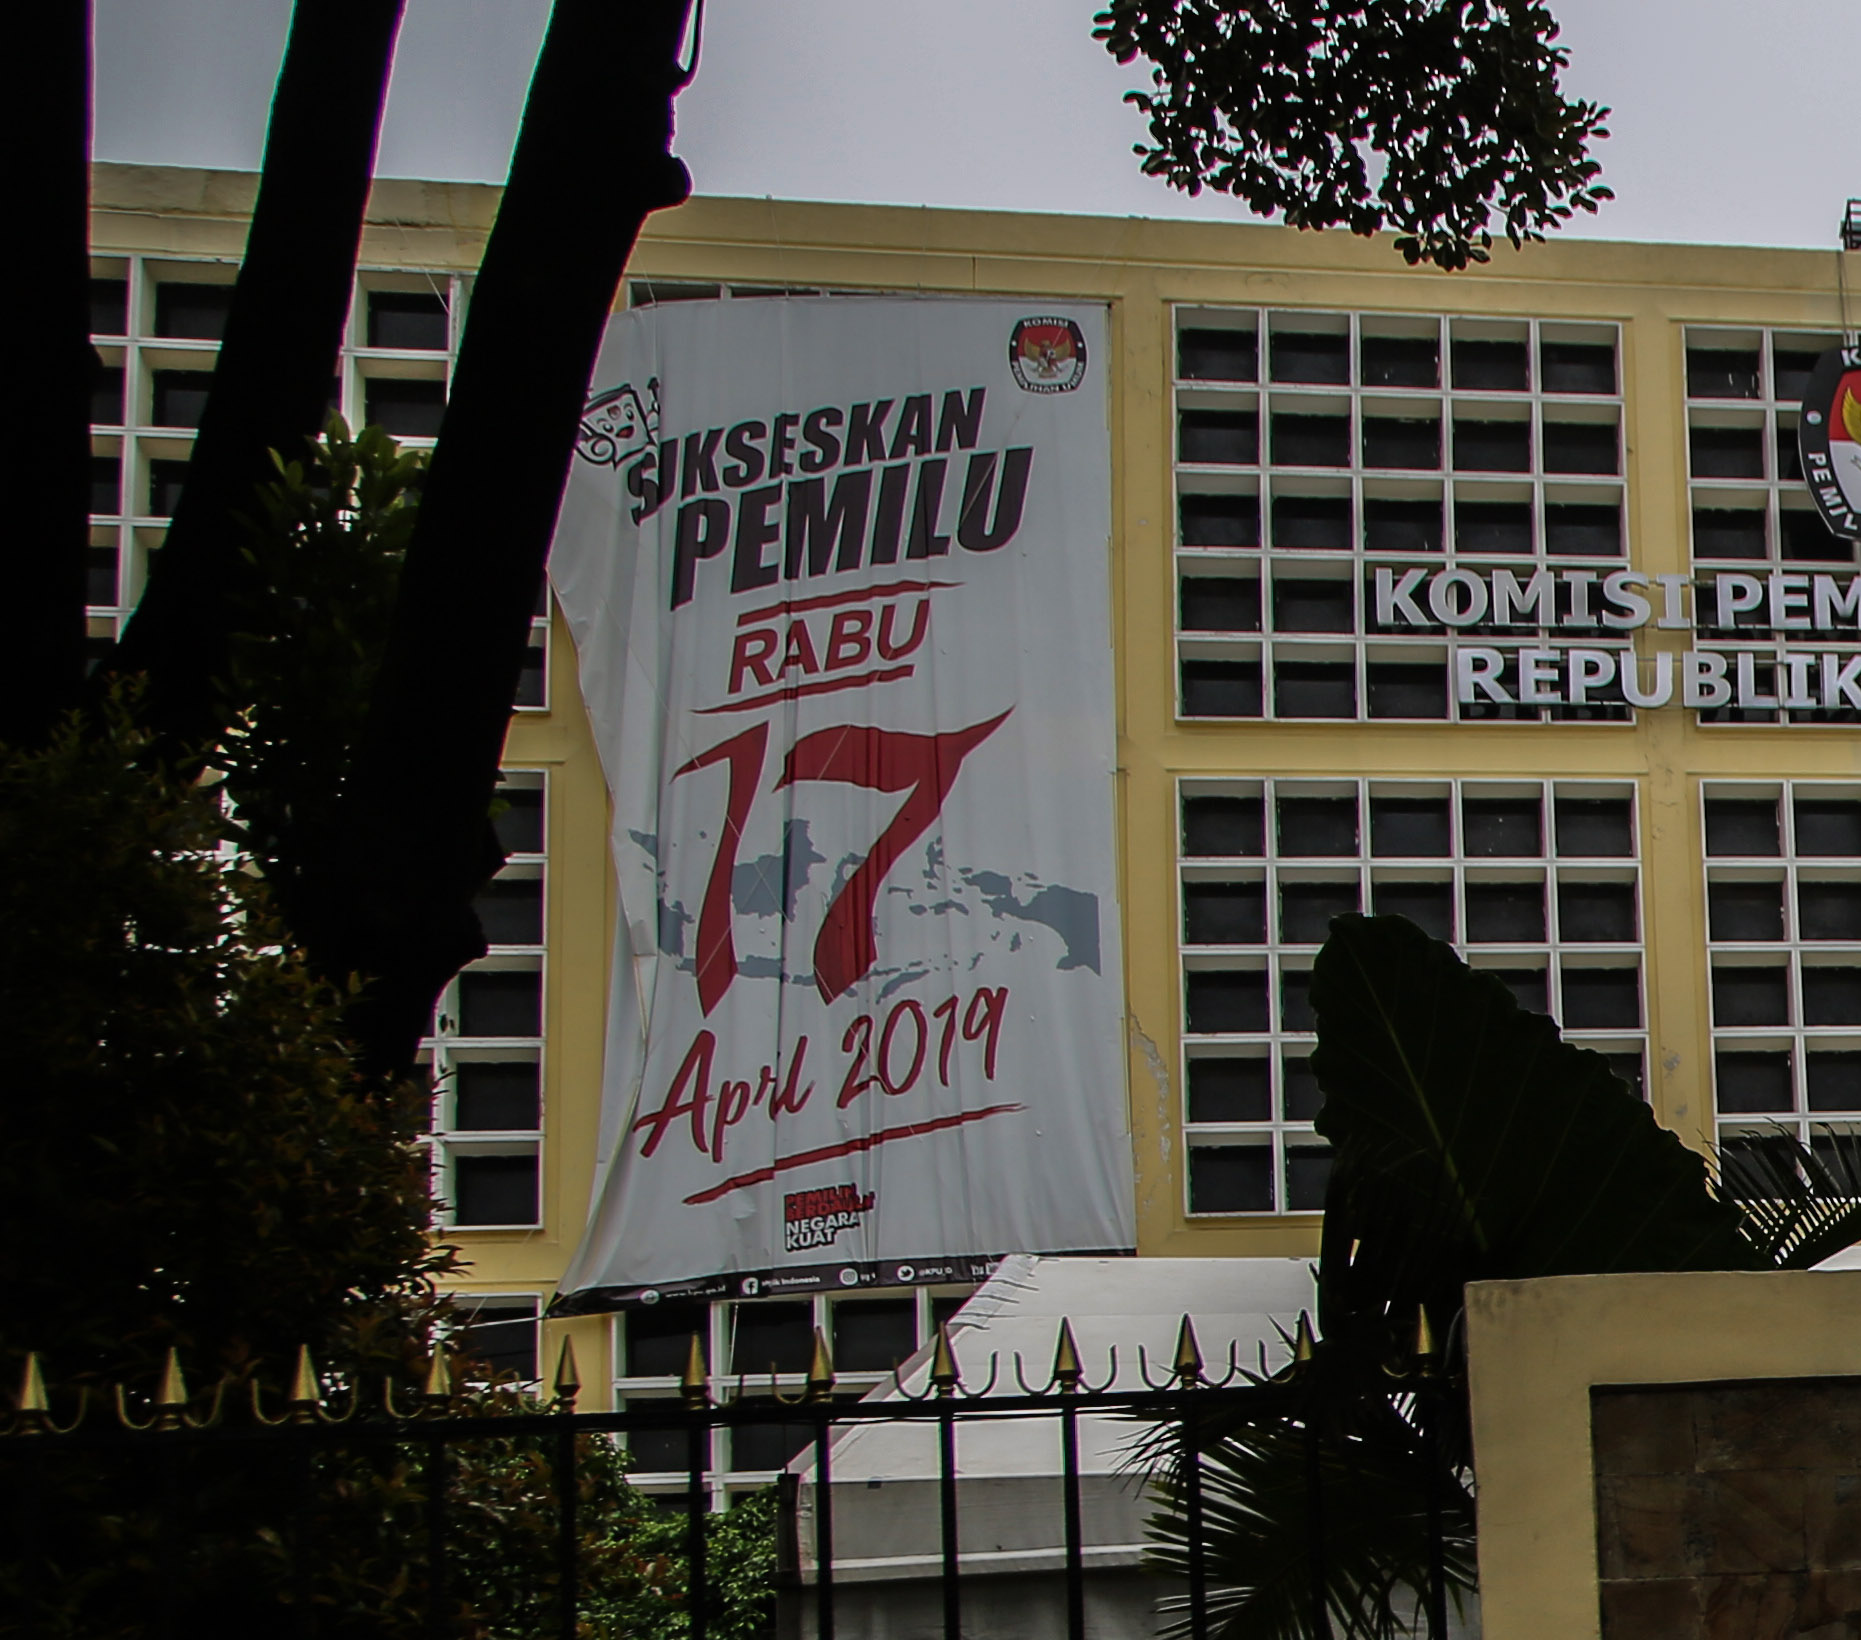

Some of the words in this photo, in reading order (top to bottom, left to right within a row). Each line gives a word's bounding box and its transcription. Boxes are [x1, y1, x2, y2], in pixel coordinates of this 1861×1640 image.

[627, 387, 986, 526] SUKSESKAN
[670, 446, 1034, 612] PEMILU
[727, 599, 930, 694] RABU
[1374, 566, 1690, 631] KOMISI
[669, 704, 1017, 1018] 17
[836, 986, 1009, 1110] 2019
[786, 1211, 860, 1236] NEGARA
[786, 1228, 836, 1250] KUAT
